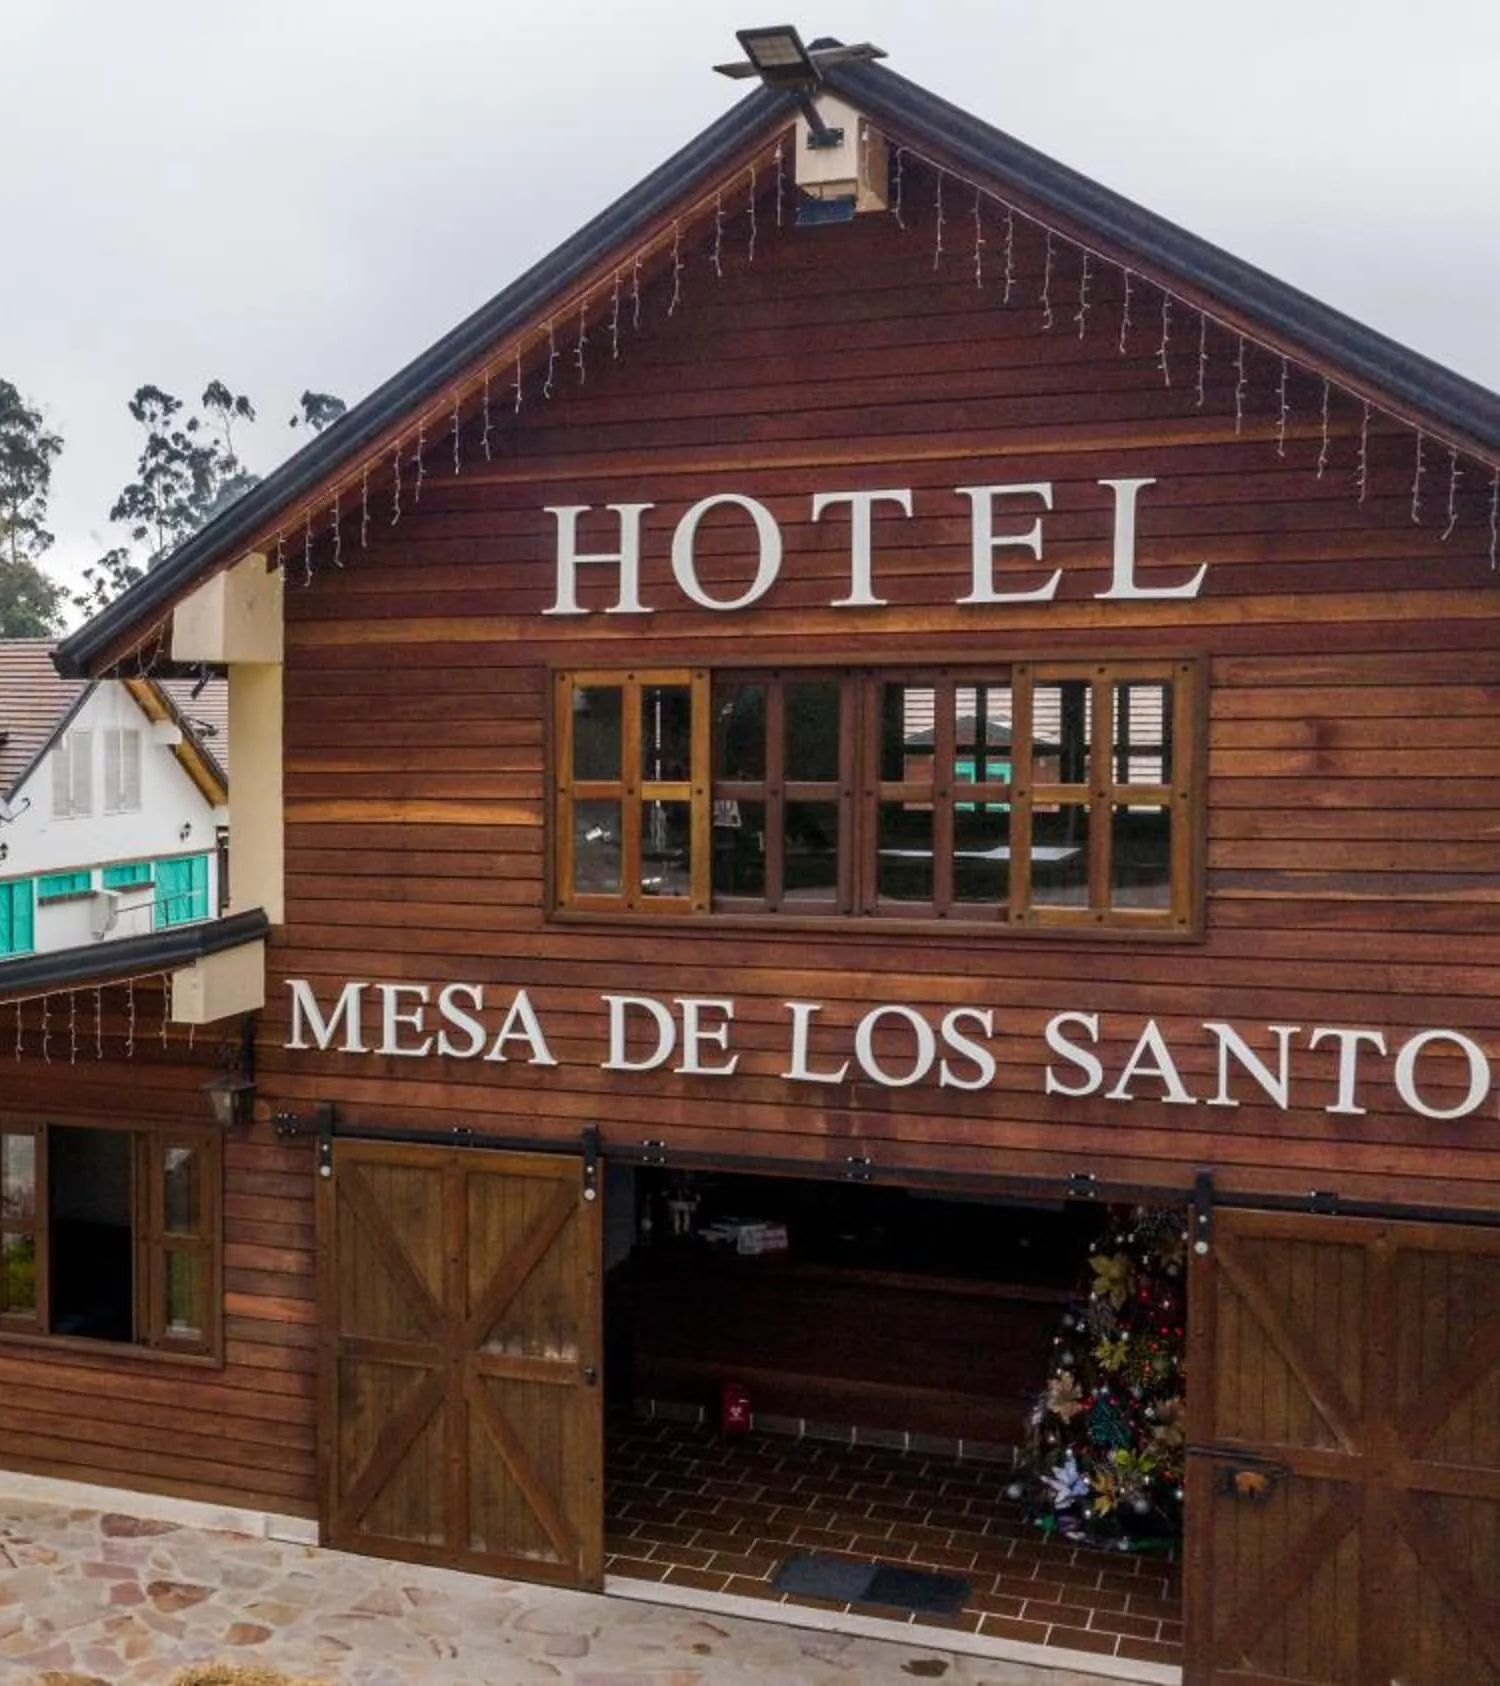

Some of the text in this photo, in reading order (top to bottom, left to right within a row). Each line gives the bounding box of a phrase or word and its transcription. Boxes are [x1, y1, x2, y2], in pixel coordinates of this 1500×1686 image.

[541, 477, 1208, 615] HOTEL
[284, 979, 1500, 1119] MESA DE LOS SANTO
